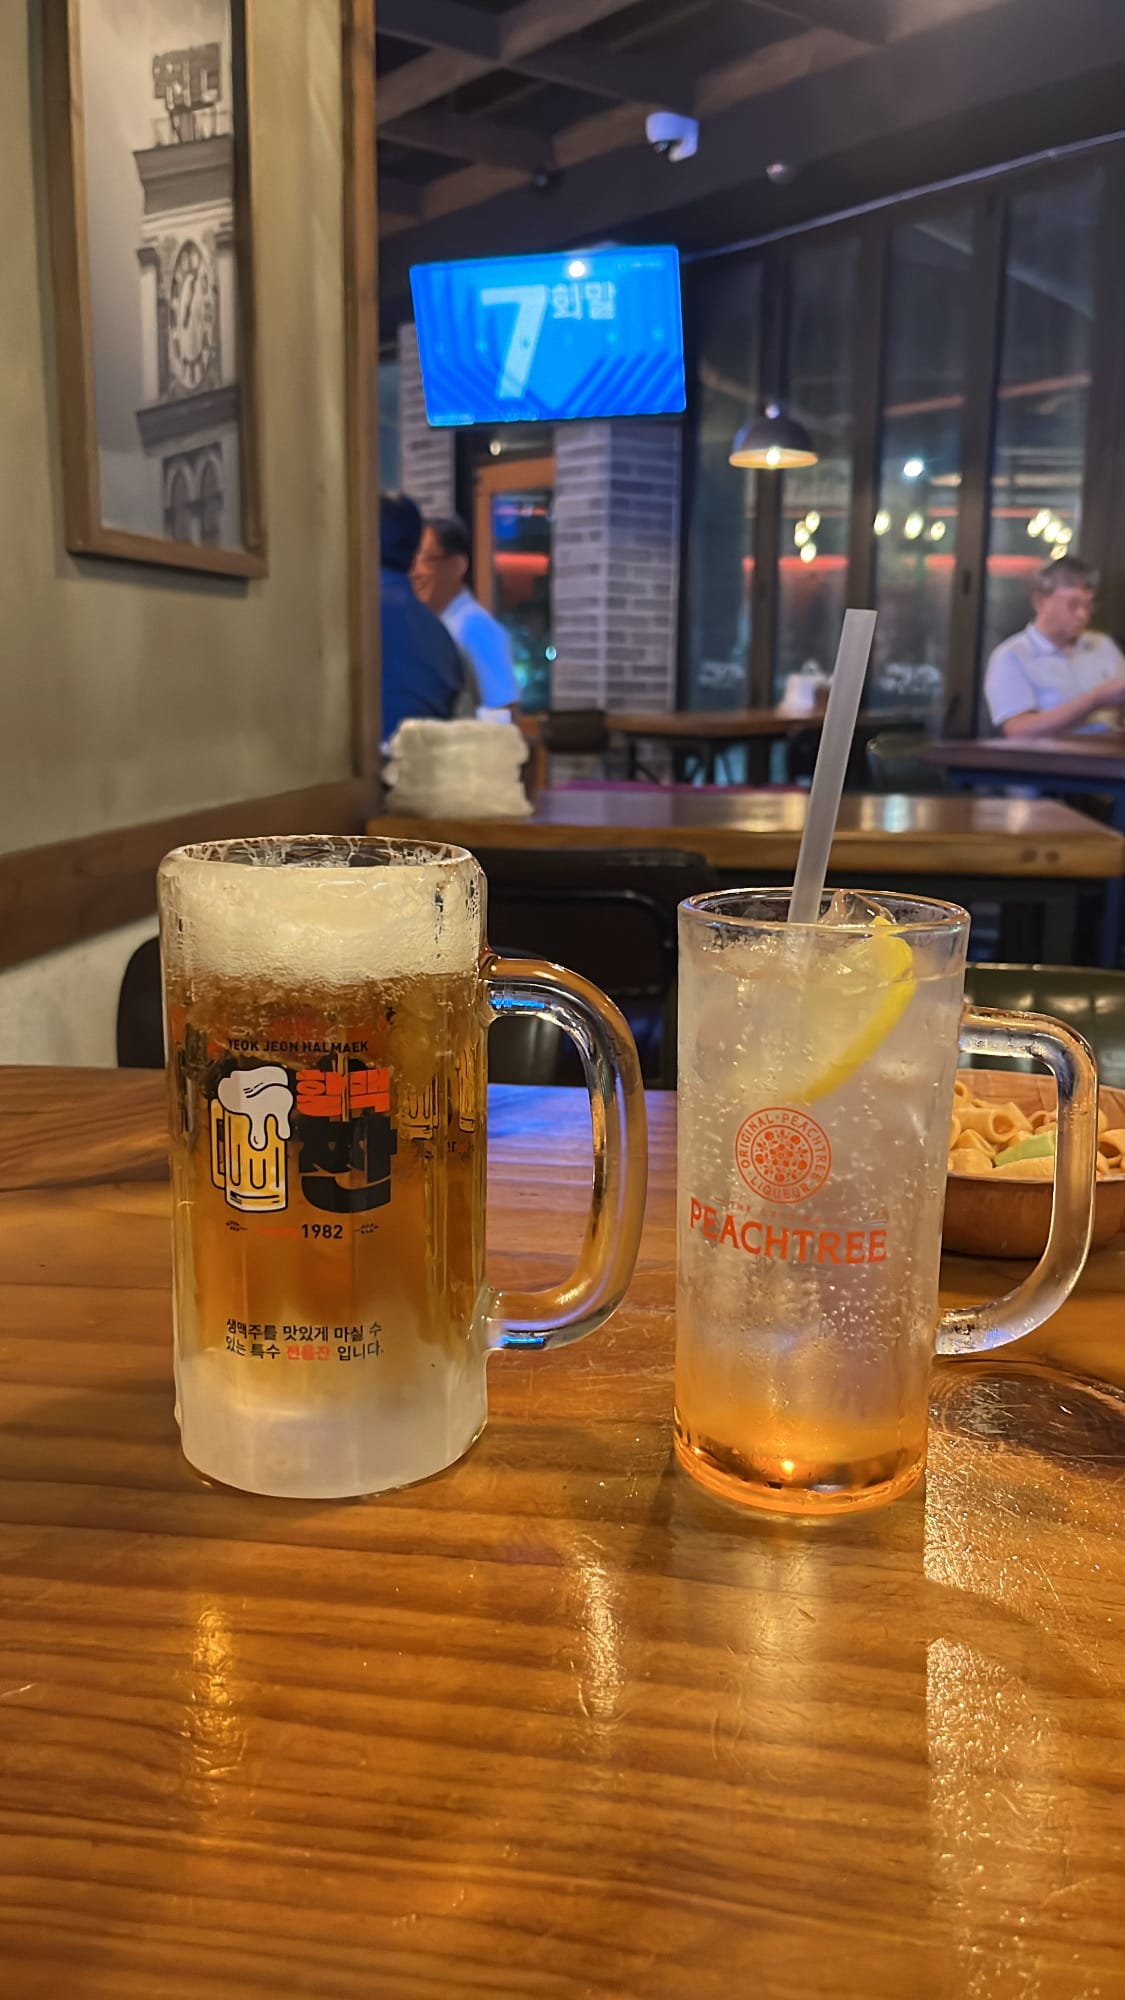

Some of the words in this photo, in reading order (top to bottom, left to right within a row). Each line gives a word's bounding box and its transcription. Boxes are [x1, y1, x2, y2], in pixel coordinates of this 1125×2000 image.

[228, 1039, 258, 1051] YEOK
[264, 1040, 299, 1052] JEON
[303, 1041, 368, 1053] HALMAEK
[740, 1113, 773, 1169] ORIGINAL
[782, 1113, 827, 1179] PEACHTREE
[750, 1175, 810, 1199] LIQUEUR
[302, 1224, 343, 1240] 1982
[690, 1197, 888, 1264] PEACHTREE
[226, 1318, 278, 1341] 생맥주를
[283, 1325, 329, 1342] 맛있게
[334, 1326, 364, 1342] 마실
[369, 1322, 383, 1337] 수
[226, 1336, 247, 1357] 있는
[250, 1343, 281, 1360] 특수
[337, 1341, 384, 1361] 입니다.
